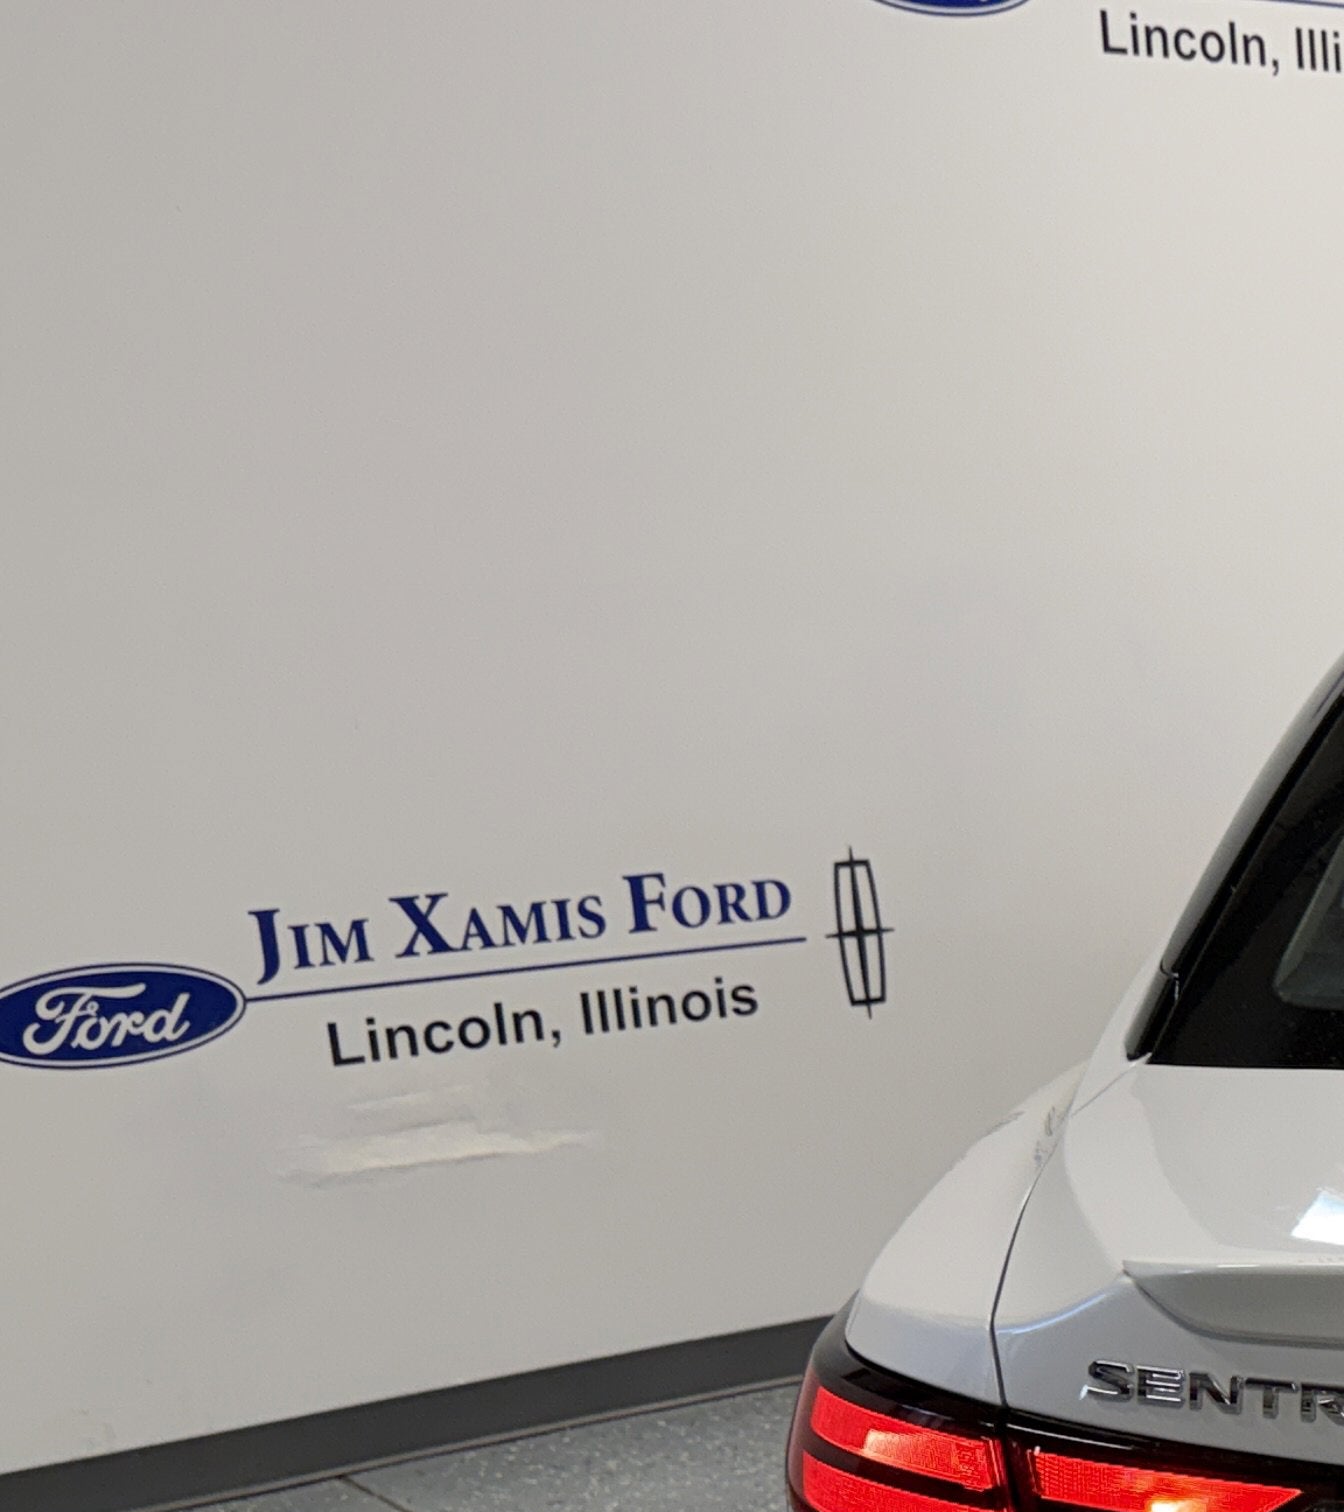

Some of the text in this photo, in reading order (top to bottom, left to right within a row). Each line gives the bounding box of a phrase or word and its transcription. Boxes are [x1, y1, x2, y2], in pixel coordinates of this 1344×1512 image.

[1101, 9, 1281, 75] Lincoln,
[246, 872, 793, 986] JIM XAMIS FORD
[21, 982, 191, 1057] Ford
[326, 975, 760, 1068] Lincoln, Illinois
